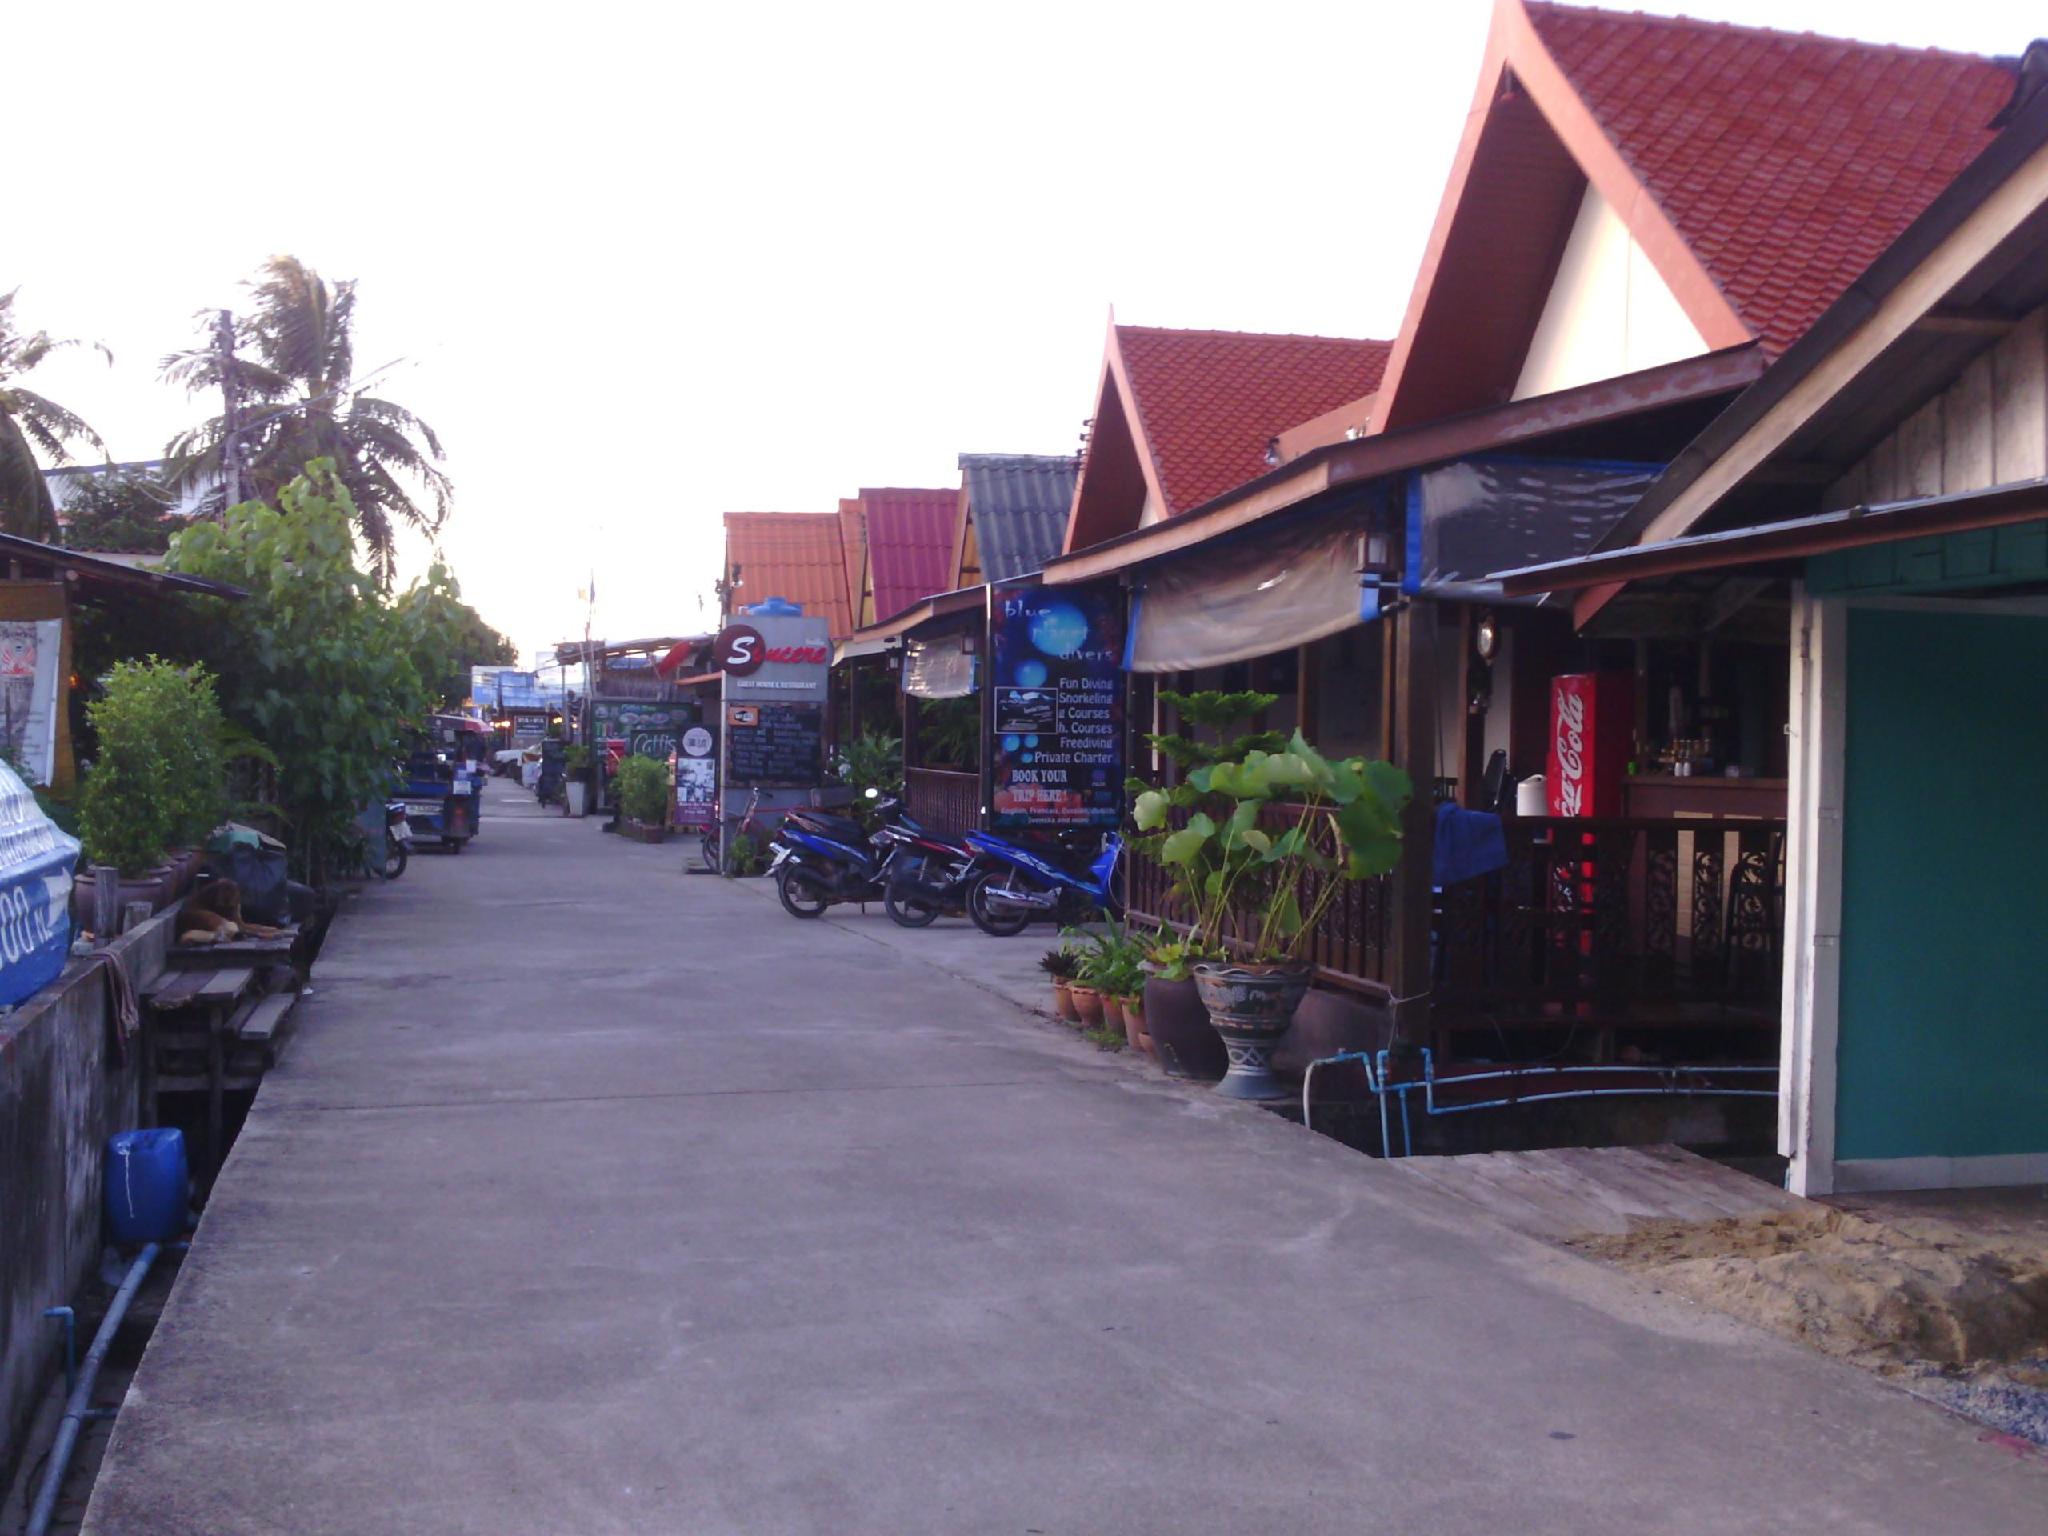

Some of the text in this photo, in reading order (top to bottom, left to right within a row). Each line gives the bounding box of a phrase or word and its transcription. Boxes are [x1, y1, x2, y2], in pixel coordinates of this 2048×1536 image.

[1005, 600, 1051, 617] blue
[1060, 642, 1112, 660] divers
[1060, 678, 1113, 690] Fun Diving
[1059, 693, 1113, 705] Snorkeling
[1068, 707, 1110, 719] Courses
[1071, 722, 1113, 734] Courses
[1060, 737, 1113, 749] Freediving
[1034, 752, 1113, 763] Private Charter
[1012, 769, 1067, 782] BOOK YOUR
[1012, 788, 1035, 802] TRIP
